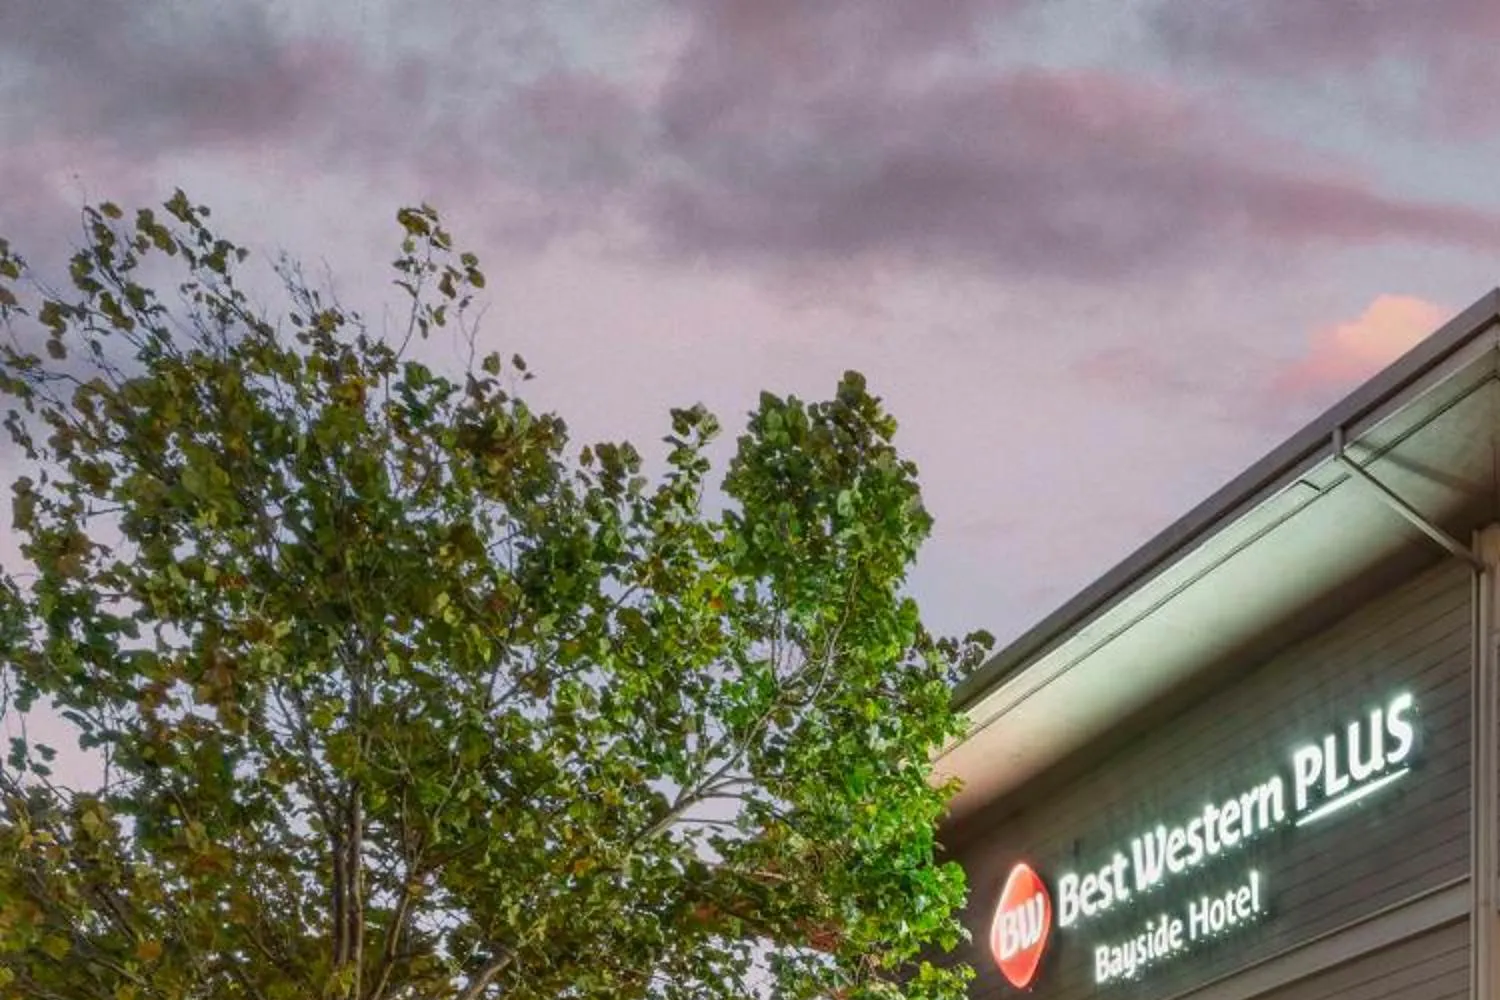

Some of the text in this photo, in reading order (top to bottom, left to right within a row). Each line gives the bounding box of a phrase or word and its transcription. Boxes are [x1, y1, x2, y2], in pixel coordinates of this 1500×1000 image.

[1058, 692, 1414, 928] Best Western PLUS
[1000, 892, 1045, 961] BW
[1095, 871, 1261, 983] Bayside Hotel
